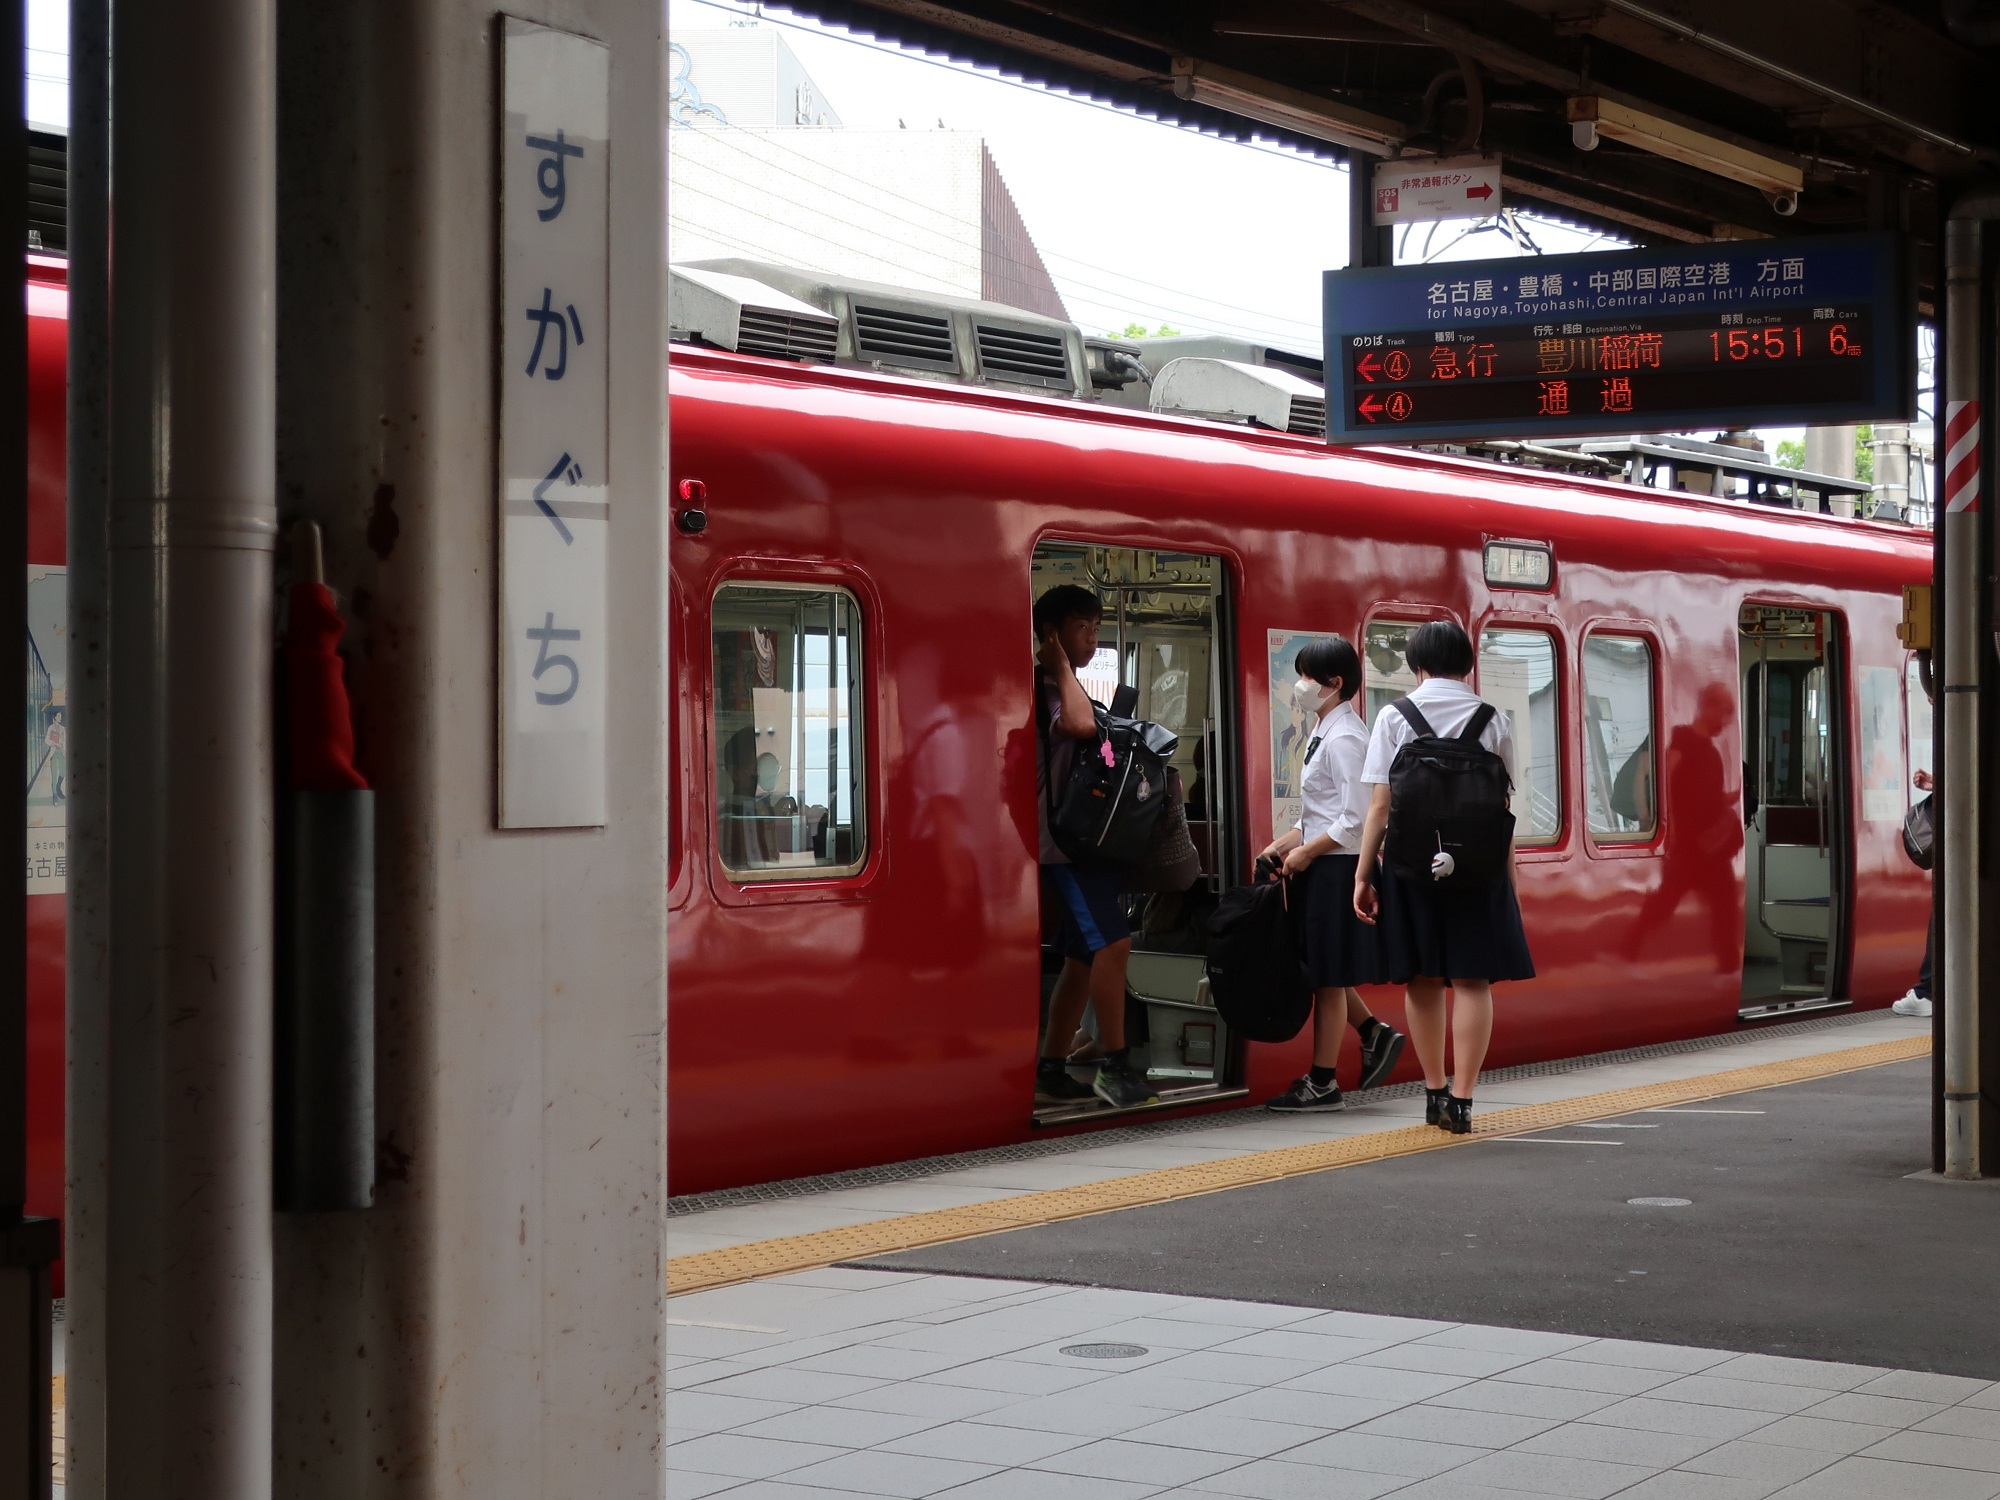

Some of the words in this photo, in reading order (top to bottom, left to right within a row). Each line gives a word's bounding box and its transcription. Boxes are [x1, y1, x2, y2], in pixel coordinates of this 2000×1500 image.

[1401, 174, 1472, 190] 非常通報ボタン
[1379, 188, 1397, 198] SOS
[1427, 262, 1730, 304] 名古屋・豊橋・中部国際空港
[1757, 257, 1805, 282] 方面
[1427, 307, 1447, 319] for
[1659, 291, 1705, 305] Japan
[1713, 287, 1743, 300] Int'l
[1750, 283, 1804, 299] Airport
[1721, 313, 1743, 325] 時刻
[1813, 308, 1835, 319] 両数
[1533, 323, 1582, 336] 行先・経由
[1353, 335, 1383, 347] のりば
[1435, 331, 1455, 342] 種別
[1430, 343, 1498, 379] 急行
[1536, 333, 1663, 374] 豊川稲荷
[1709, 327, 1802, 362] 15:51
[525, 128, 585, 706] すかぐち
